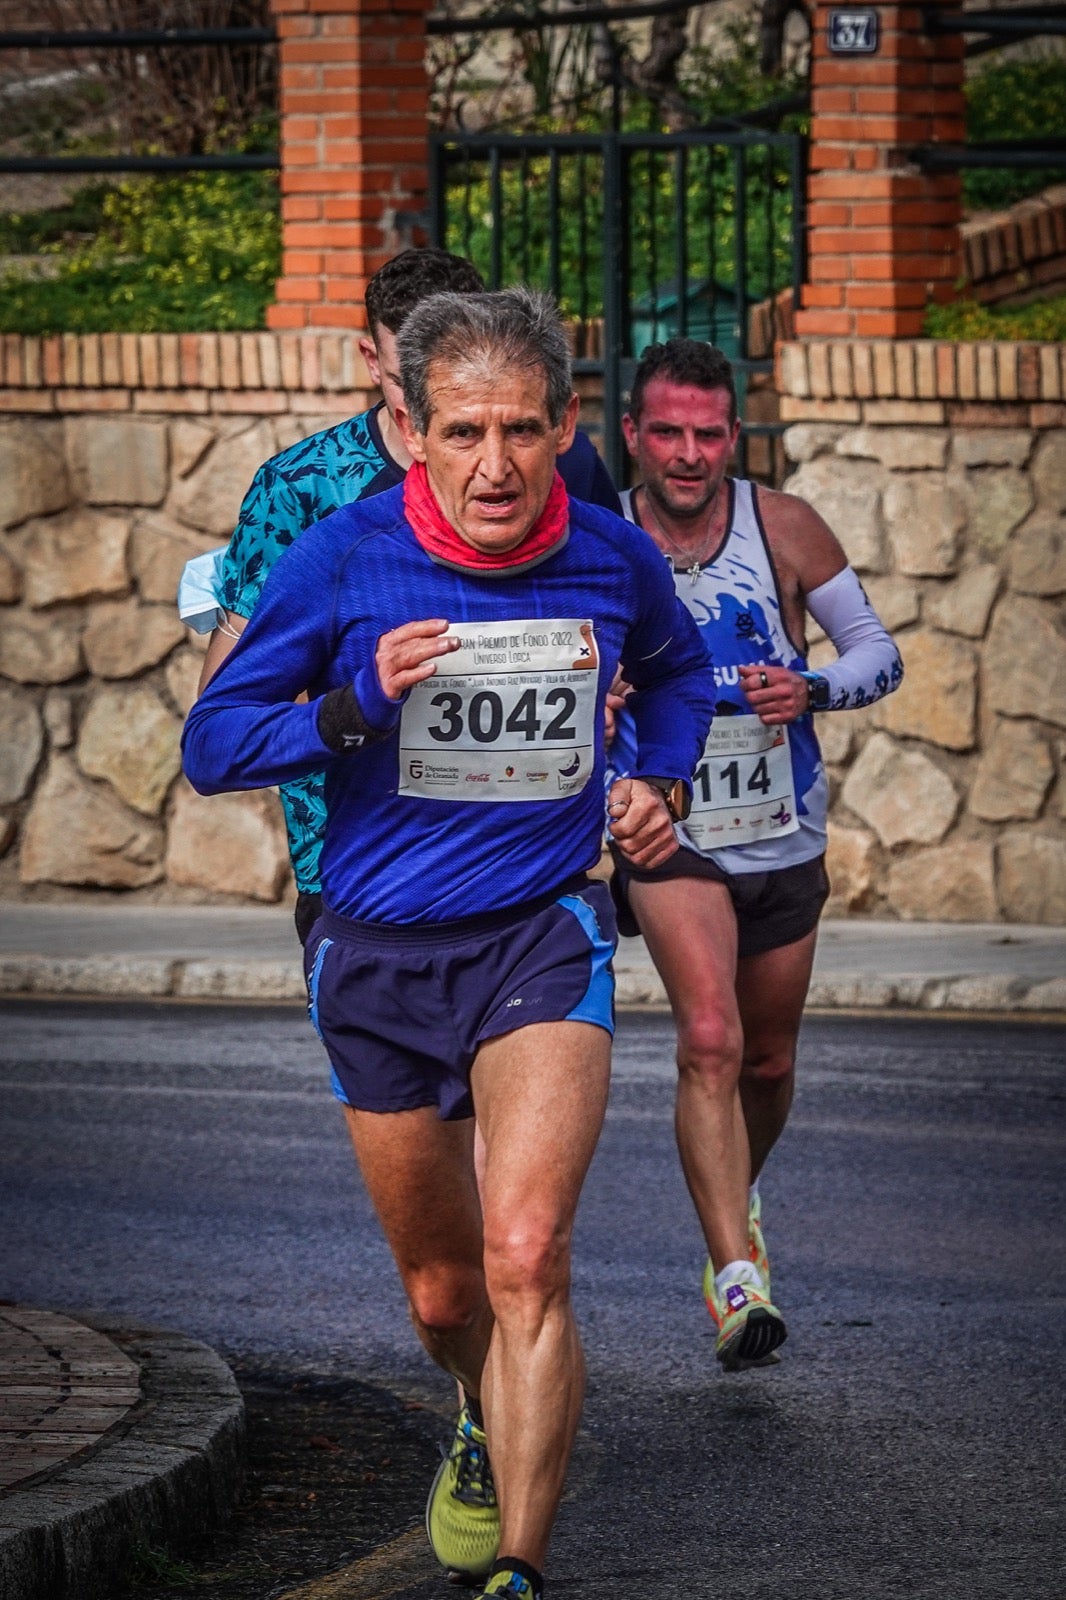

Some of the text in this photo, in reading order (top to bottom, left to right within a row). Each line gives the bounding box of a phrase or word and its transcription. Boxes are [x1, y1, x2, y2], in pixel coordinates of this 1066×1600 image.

[459, 638, 475, 649] RAN
[551, 631, 573, 646] 2022
[427, 687, 577, 742] 3042
[692, 756, 771, 802] 114
